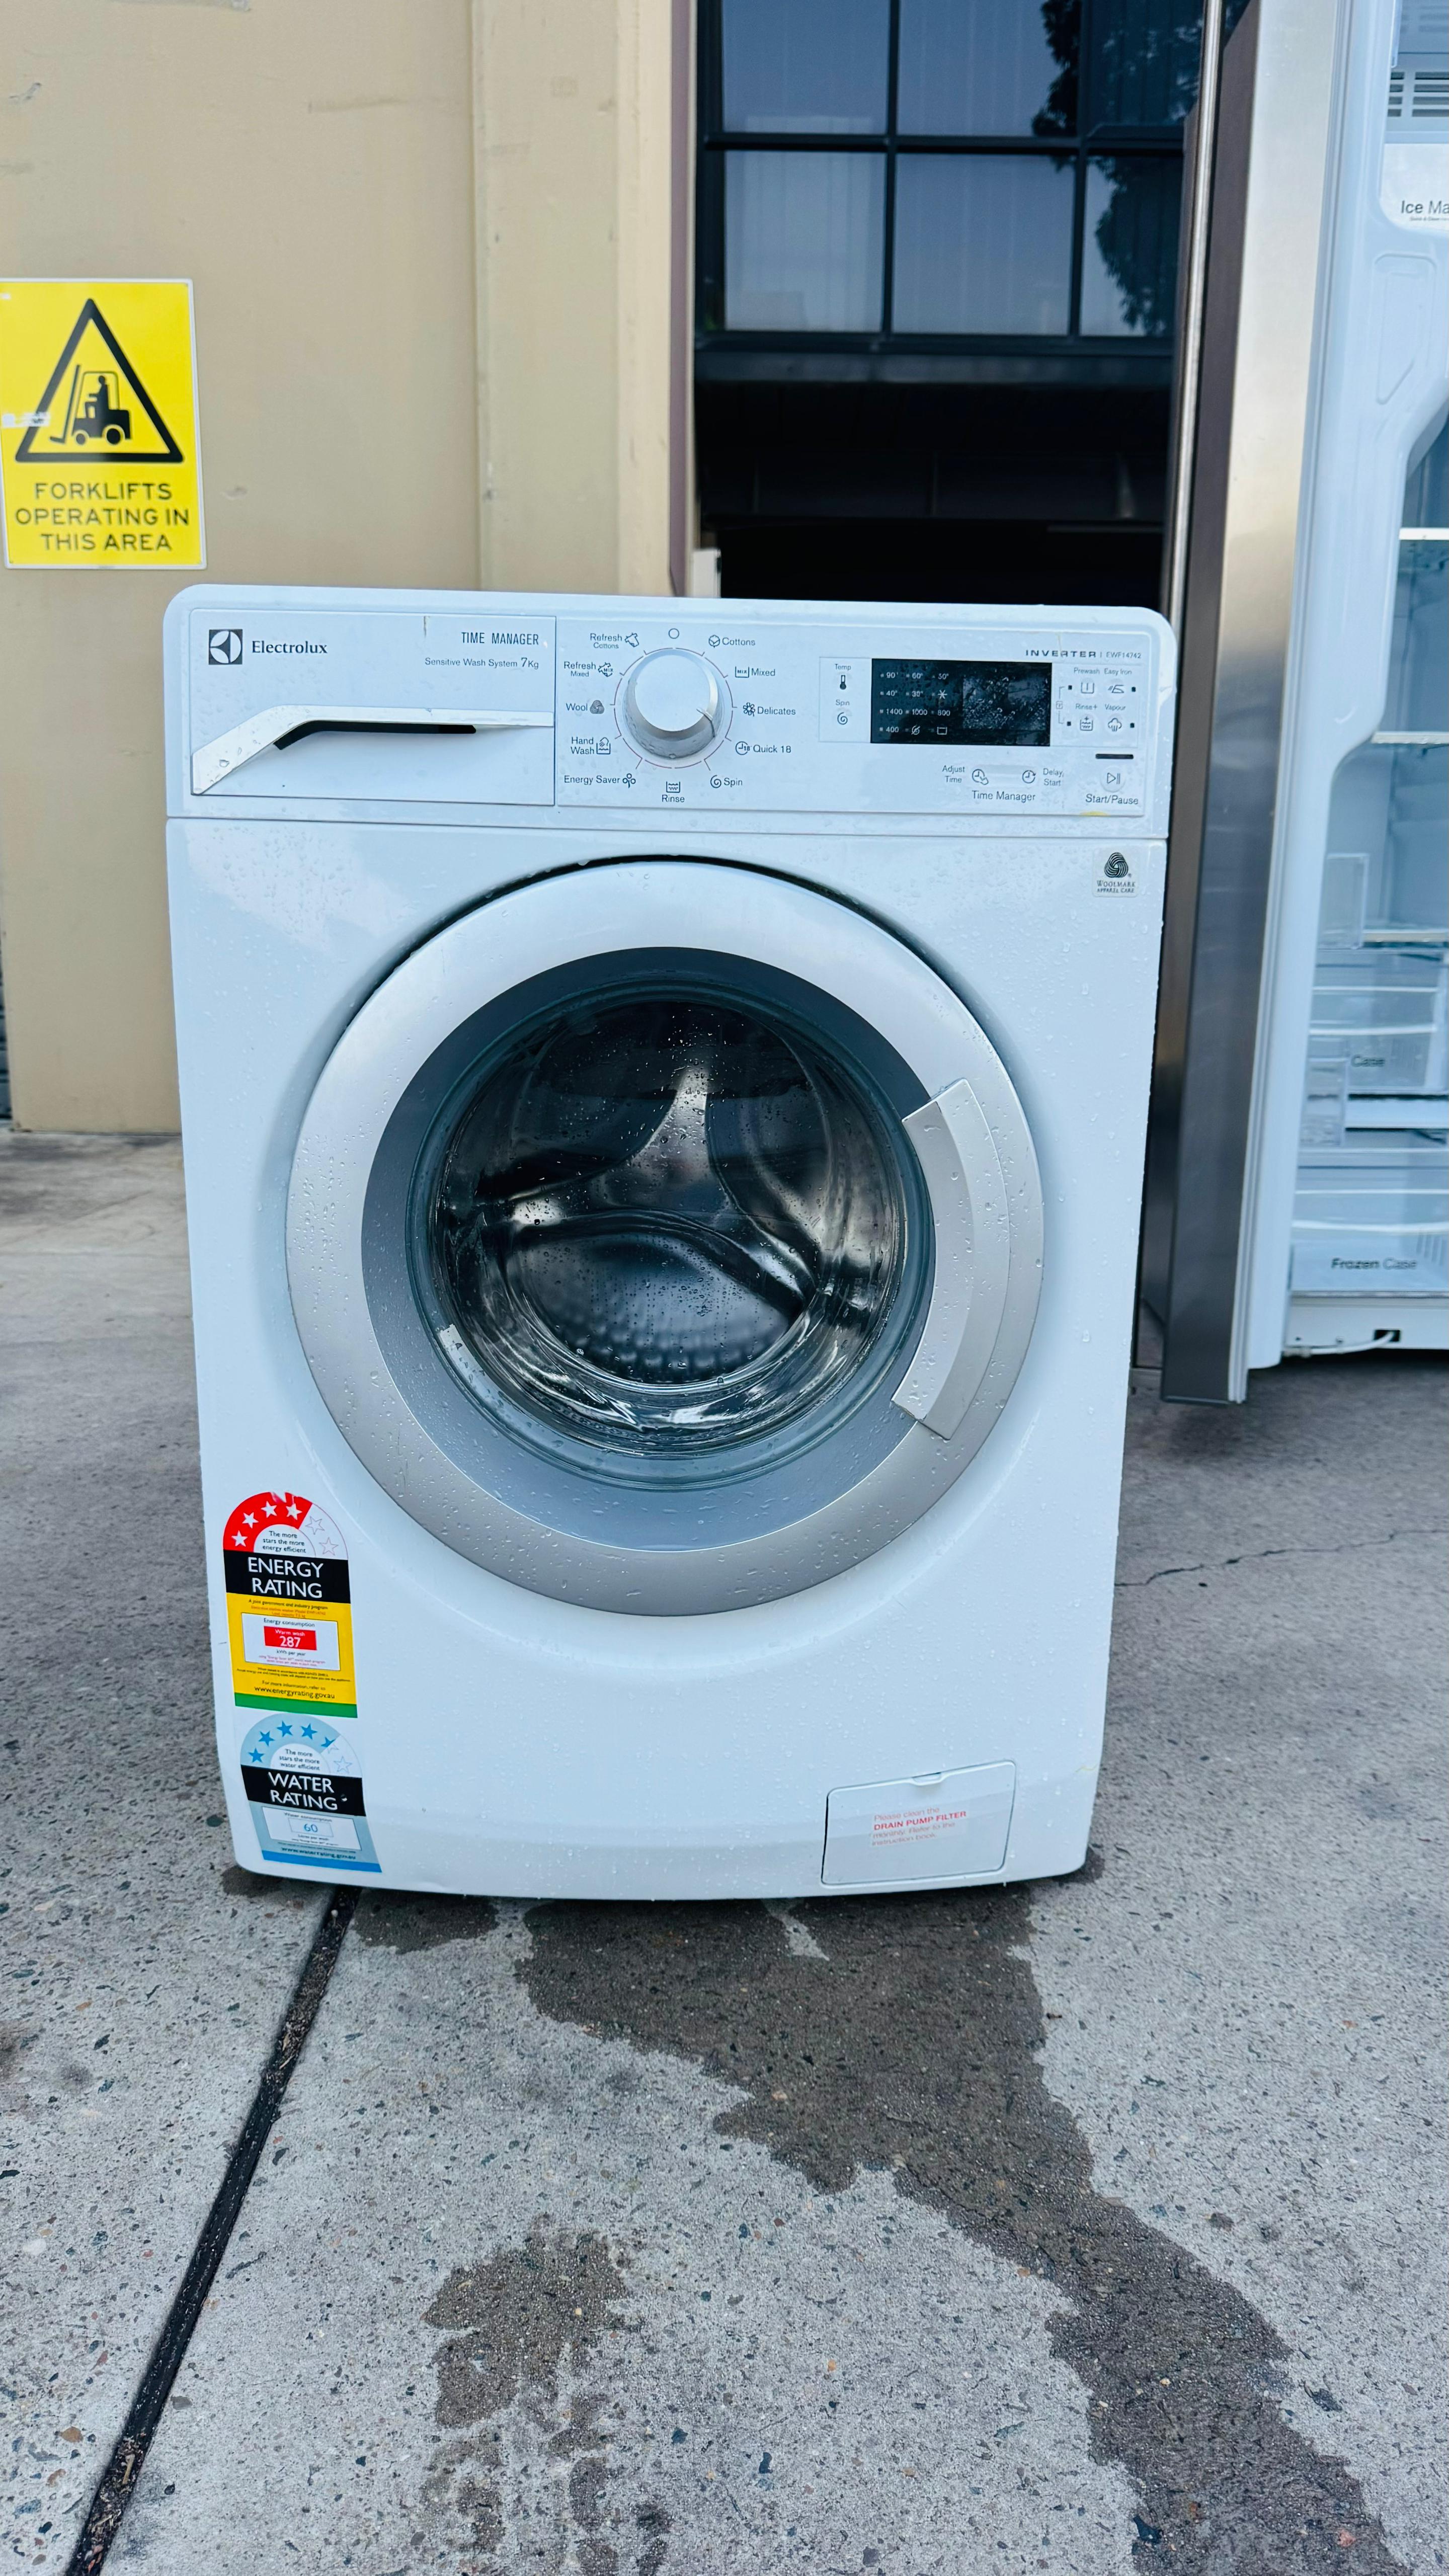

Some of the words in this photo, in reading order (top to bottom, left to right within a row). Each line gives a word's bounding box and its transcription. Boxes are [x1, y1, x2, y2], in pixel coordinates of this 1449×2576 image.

[1401, 200, 1423, 213] Ice
[35, 482, 173, 500] FORKLIFTS
[16, 508, 158, 526] OPERATING
[166, 509, 190, 526] IN
[41, 533, 96, 551] THIS
[104, 534, 172, 551] AREA
[461, 632, 485, 643] TIME
[492, 632, 539, 645] MANAGER
[590, 633, 622, 641] Refresh
[722, 637, 756, 646] Cottons
[252, 640, 328, 654] Electrolux
[1025, 650, 1096, 658] INVERTER
[425, 657, 460, 666] Sensitive
[463, 658, 486, 666] Wash
[488, 659, 518, 669] System
[564, 661, 596, 670] Refresh
[751, 668, 775, 676] Mixed
[1104, 668, 1118, 676] Easy
[566, 703, 588, 711] Wool
[757, 706, 796, 715] Delicates
[1105, 704, 1126, 712] Vapour
[571, 737, 594, 745] Hand
[571, 747, 595, 755] Wash
[753, 745, 778, 753] Quick
[942, 765, 965, 774] Adjust
[1043, 768, 1063, 777] Delay
[564, 775, 593, 785] Energy
[596, 775, 620, 783] Saver
[723, 777, 743, 788] Spin
[1043, 778, 1061, 786] Start
[662, 794, 685, 802] Rinse
[972, 790, 993, 800] Time
[996, 791, 1036, 803] Manager
[1086, 793, 1139, 805] Start/Pause
[1351, 1054, 1386, 1067] Case
[1331, 1257, 1380, 1269] Frozen
[1383, 1257, 1418, 1269] Case
[247, 1557, 324, 1578] ENERGY
[252, 1577, 323, 1599] RATING
[264, 1618, 281, 1626] Energy
[279, 1635, 301, 1648] 287
[268, 1772, 335, 1794] WATER
[270, 1789, 338, 1811] RATING
[874, 1813, 902, 1821] Please
[903, 1810, 925, 1818] clean
[873, 1820, 904, 1831] DRAIN
[906, 1816, 934, 1827] PUMP
[936, 1811, 967, 1822] FILTER
[303, 1823, 318, 1833] 60
